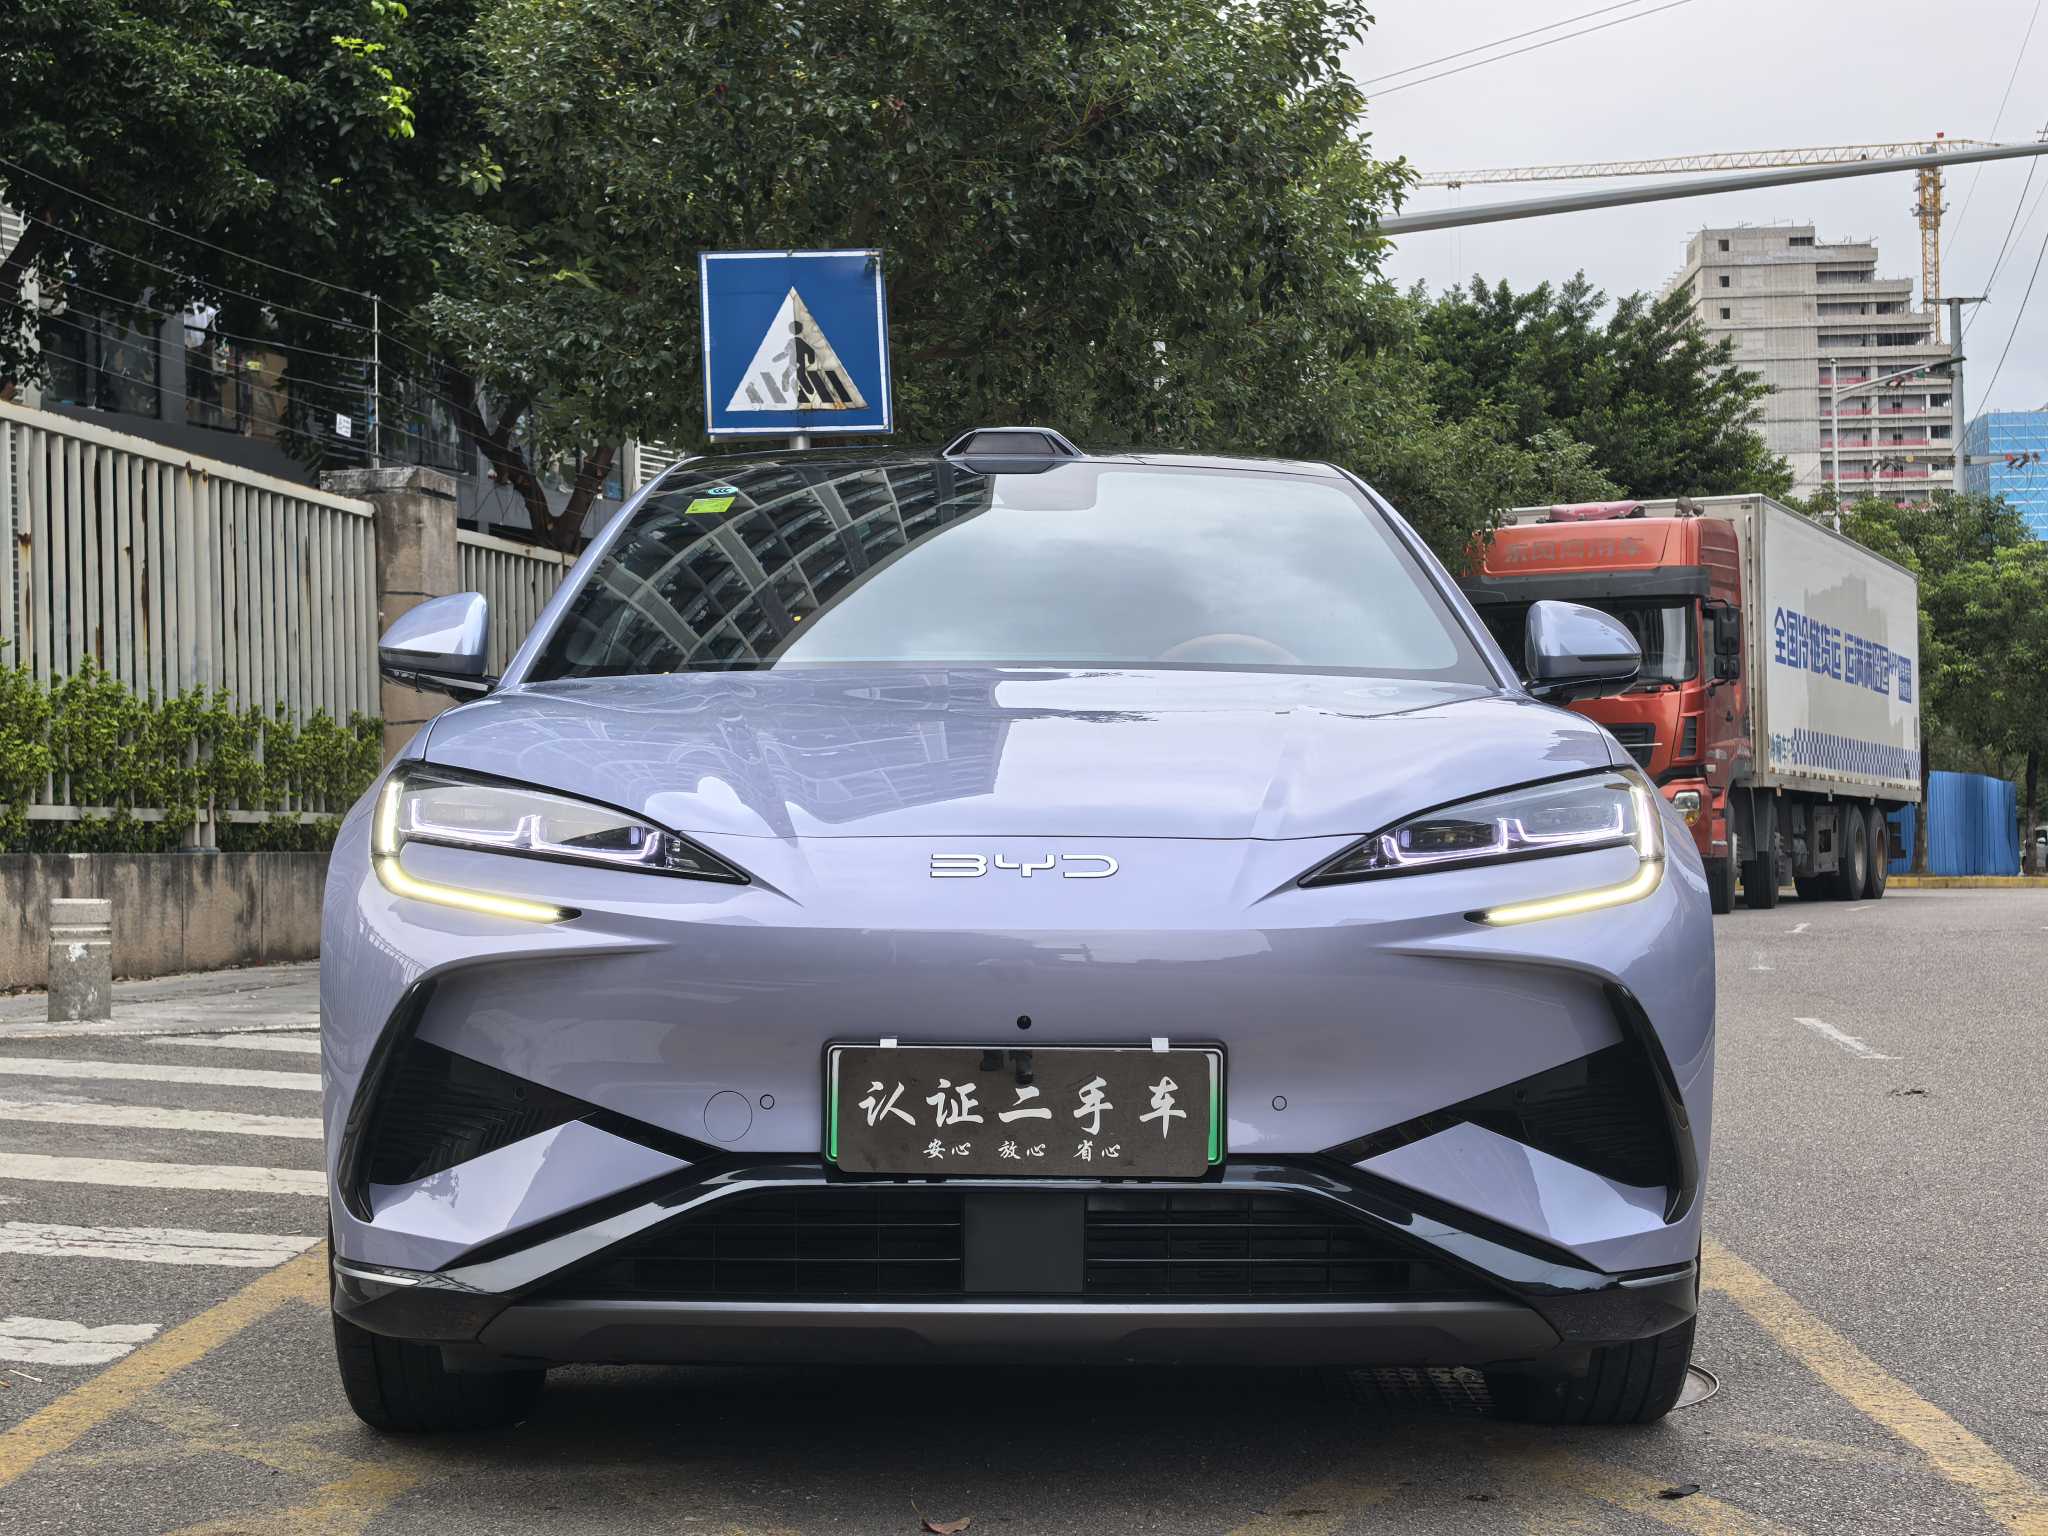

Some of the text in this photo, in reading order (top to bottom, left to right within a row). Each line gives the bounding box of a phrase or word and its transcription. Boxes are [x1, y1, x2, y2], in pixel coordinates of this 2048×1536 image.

[930, 853, 1119, 878] BYD
[858, 1075, 1187, 1140] 认证二手车
[923, 1139, 1121, 1162] 安心 放心 省心
